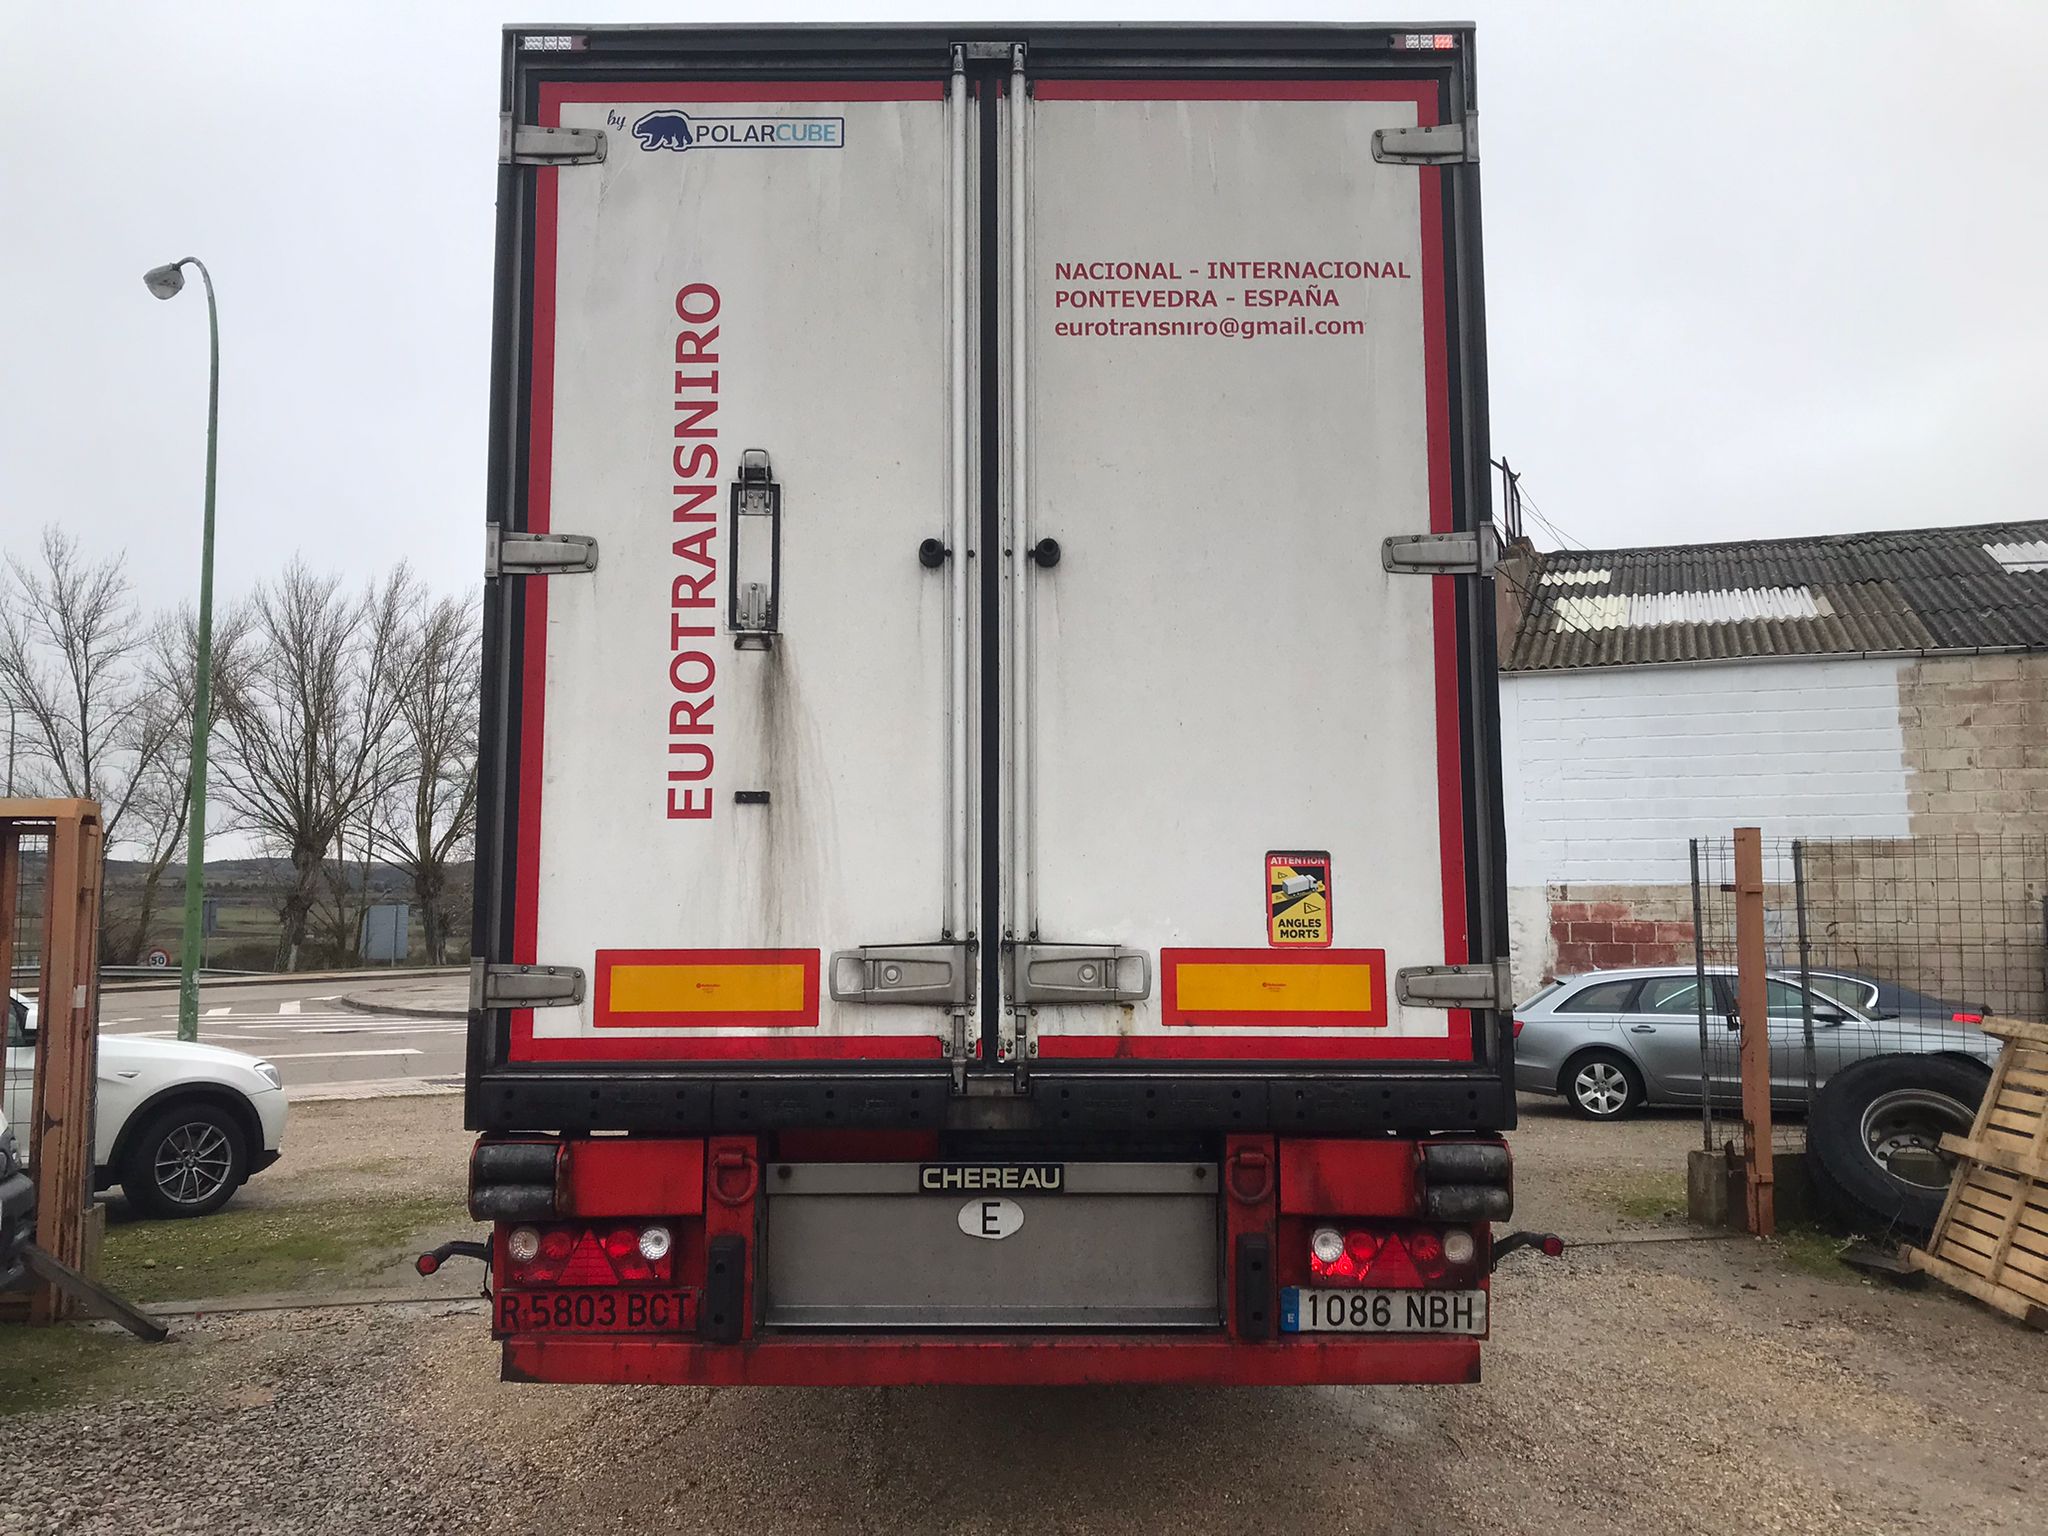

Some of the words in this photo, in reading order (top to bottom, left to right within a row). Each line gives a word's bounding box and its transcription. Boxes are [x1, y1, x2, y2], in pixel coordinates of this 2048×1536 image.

[607, 109, 626, 131] by
[696, 124, 836, 142] POLARCUBE
[1055, 262, 1182, 280] NACIONAL
[1207, 261, 1411, 279] INTERNACIONAL
[1055, 290, 1218, 308] PONTEVEDRA
[1244, 284, 1340, 307] ESPAÑA
[667, 282, 721, 819] EUROTRANSNIRO
[1270, 856, 1325, 865] ATTENTION
[1278, 918, 1322, 928] ANGLES
[1280, 929, 1320, 938] MORTS
[151, 956, 165, 965] 50
[922, 1167, 1060, 1189] CHEREAU
[982, 1202, 1000, 1234] E
[532, 1294, 617, 1328] 5803
[628, 1293, 691, 1327] BCT
[1287, 1313, 1295, 1323] E
[1308, 1294, 1391, 1327] 1086
[1406, 1295, 1473, 1329] NBH
